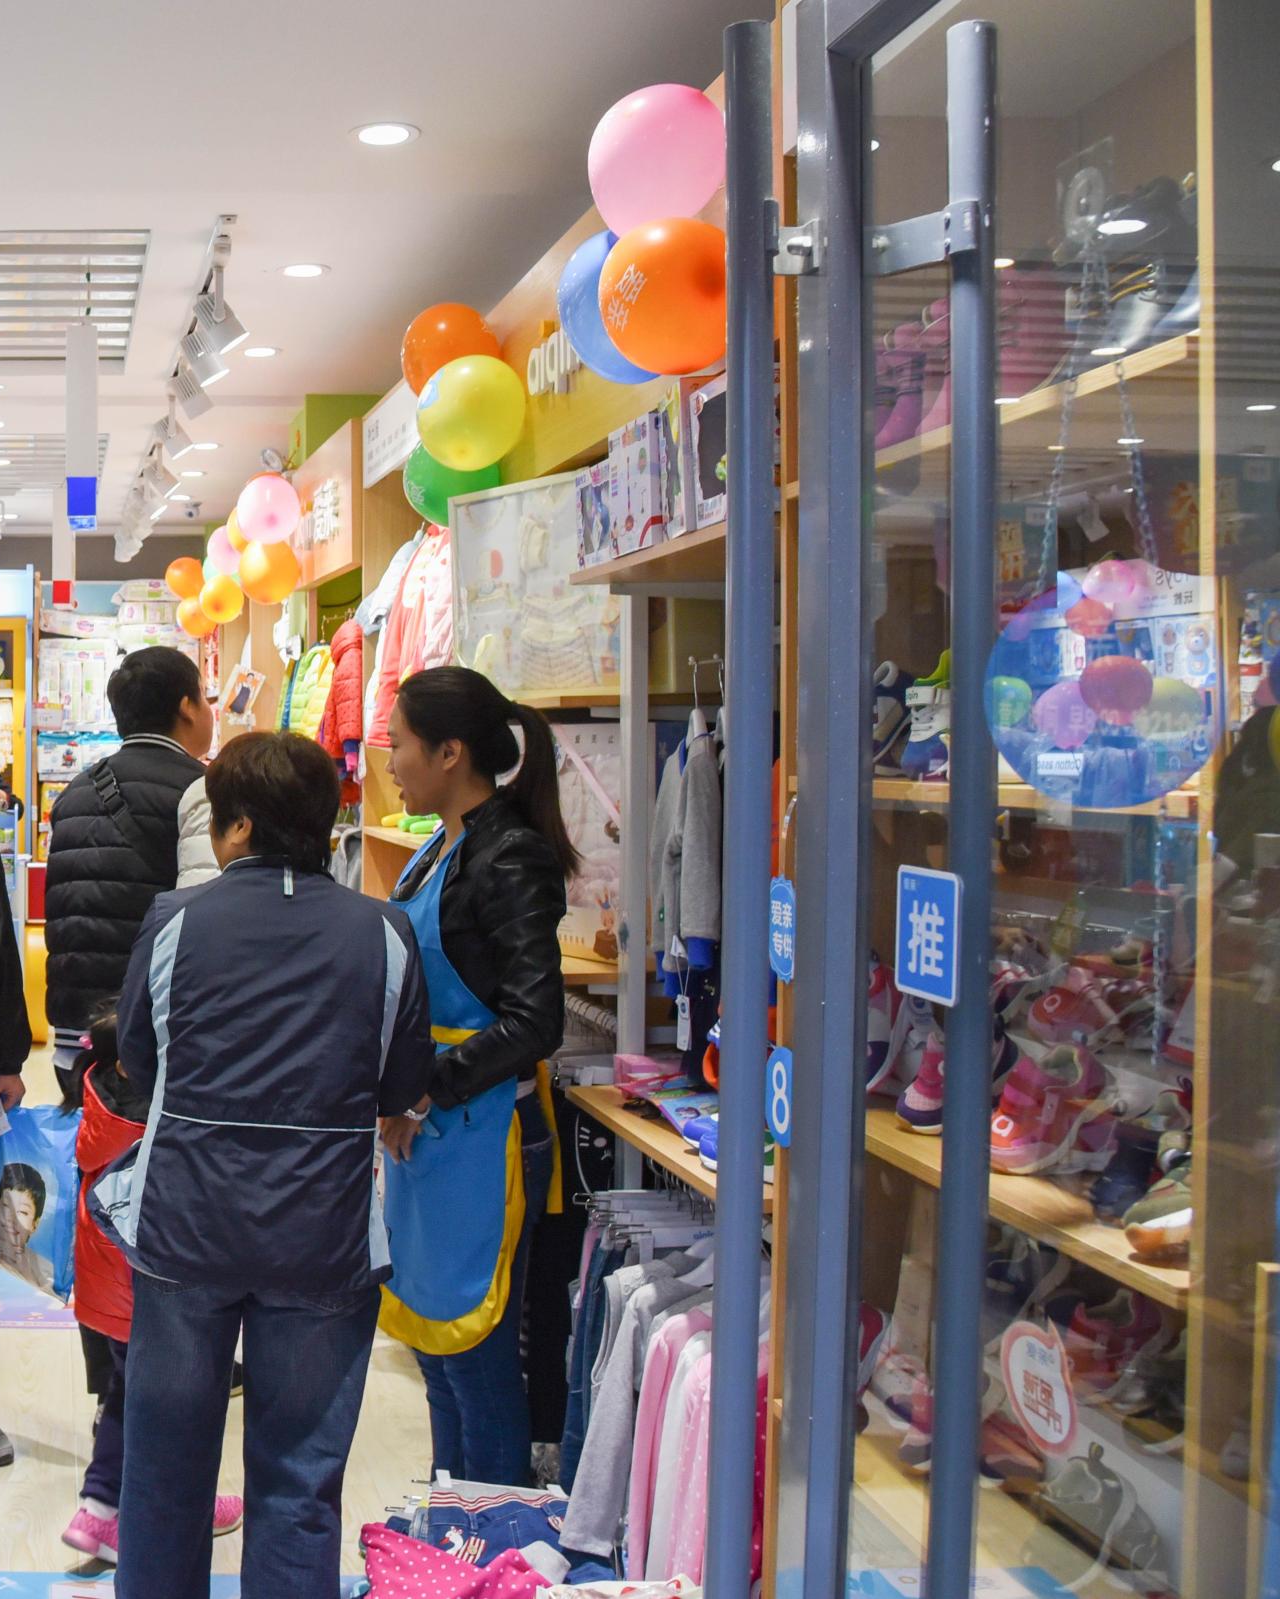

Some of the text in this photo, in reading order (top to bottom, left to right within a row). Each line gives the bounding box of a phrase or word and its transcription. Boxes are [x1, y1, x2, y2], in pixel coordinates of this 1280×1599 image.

[771, 899, 793, 928] 爱亲
[773, 930, 793, 961] 专供
[907, 899, 945, 977] 推
